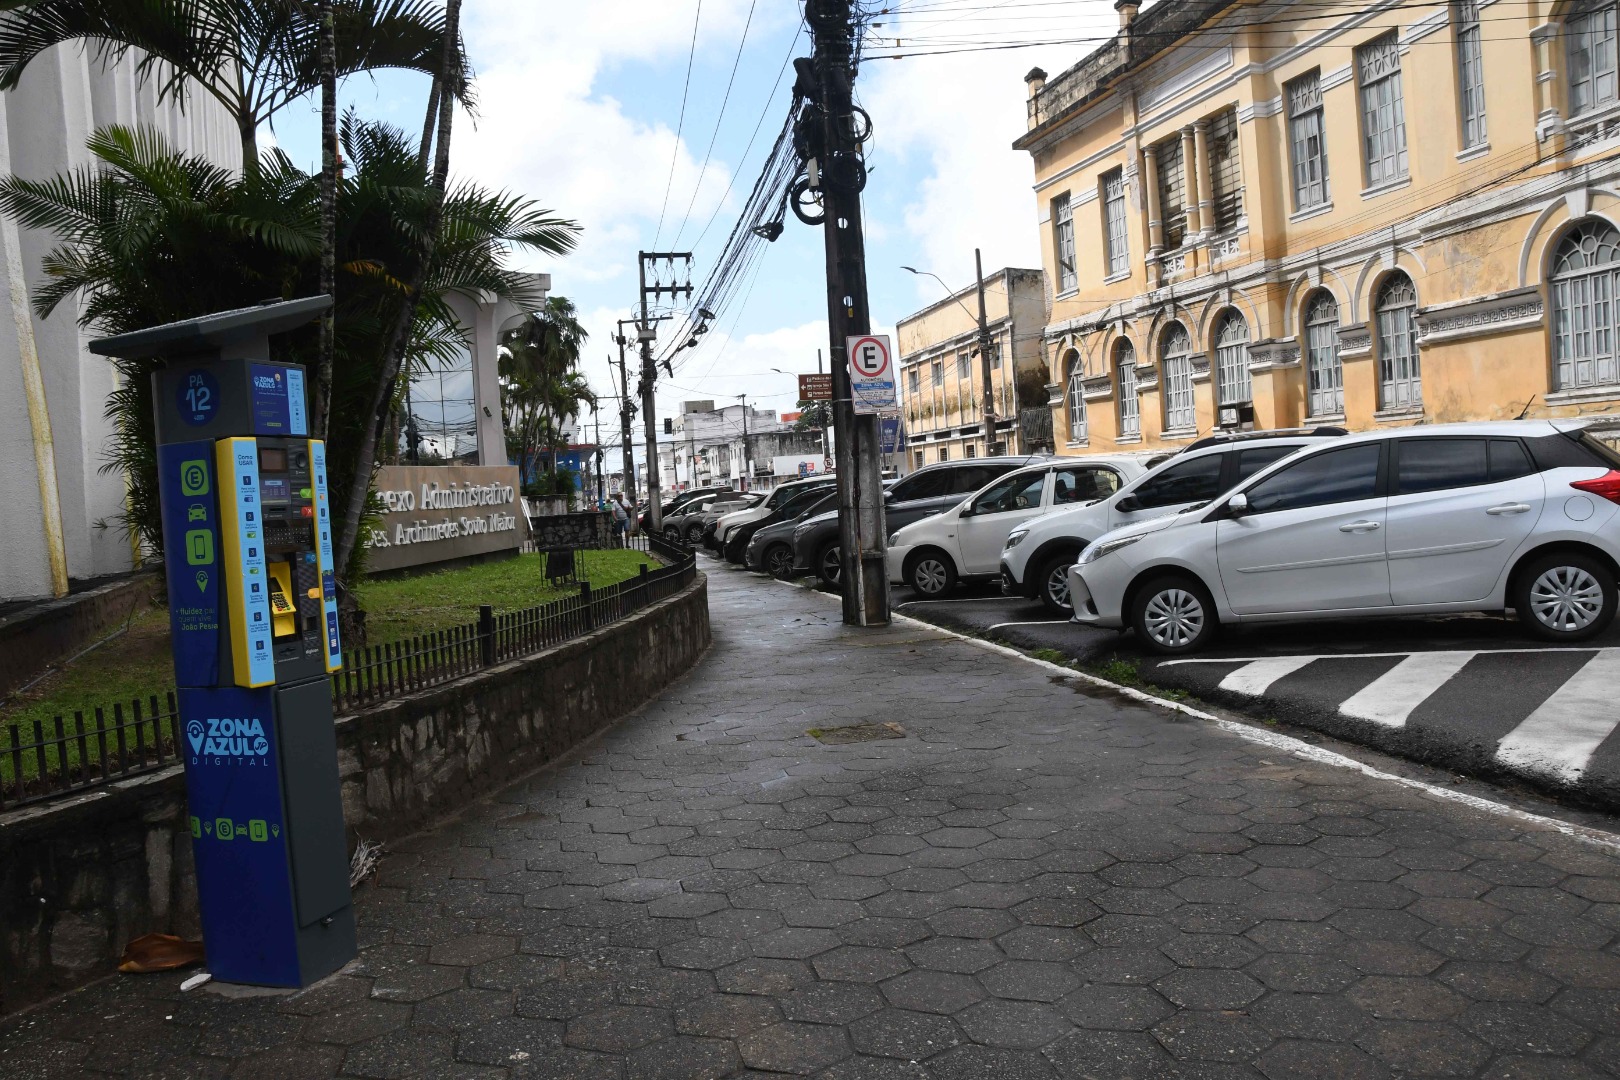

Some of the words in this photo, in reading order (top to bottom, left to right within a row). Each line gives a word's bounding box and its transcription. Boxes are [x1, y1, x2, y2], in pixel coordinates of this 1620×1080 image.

[863, 347, 877, 369] E
[190, 375, 204, 387] PA
[186, 387, 211, 411] 12
[190, 471, 200, 485] E
[375, 490, 415, 514] nexo
[420, 482, 514, 510] Administrativo
[394, 519, 459, 546] Archimedes
[460, 516, 488, 539] Souto
[488, 511, 516, 533] Maior
[181, 623, 198, 631] João
[207, 718, 265, 737] ZONA
[204, 737, 254, 756] AZUL
[192, 757, 269, 767] DIGITAL
